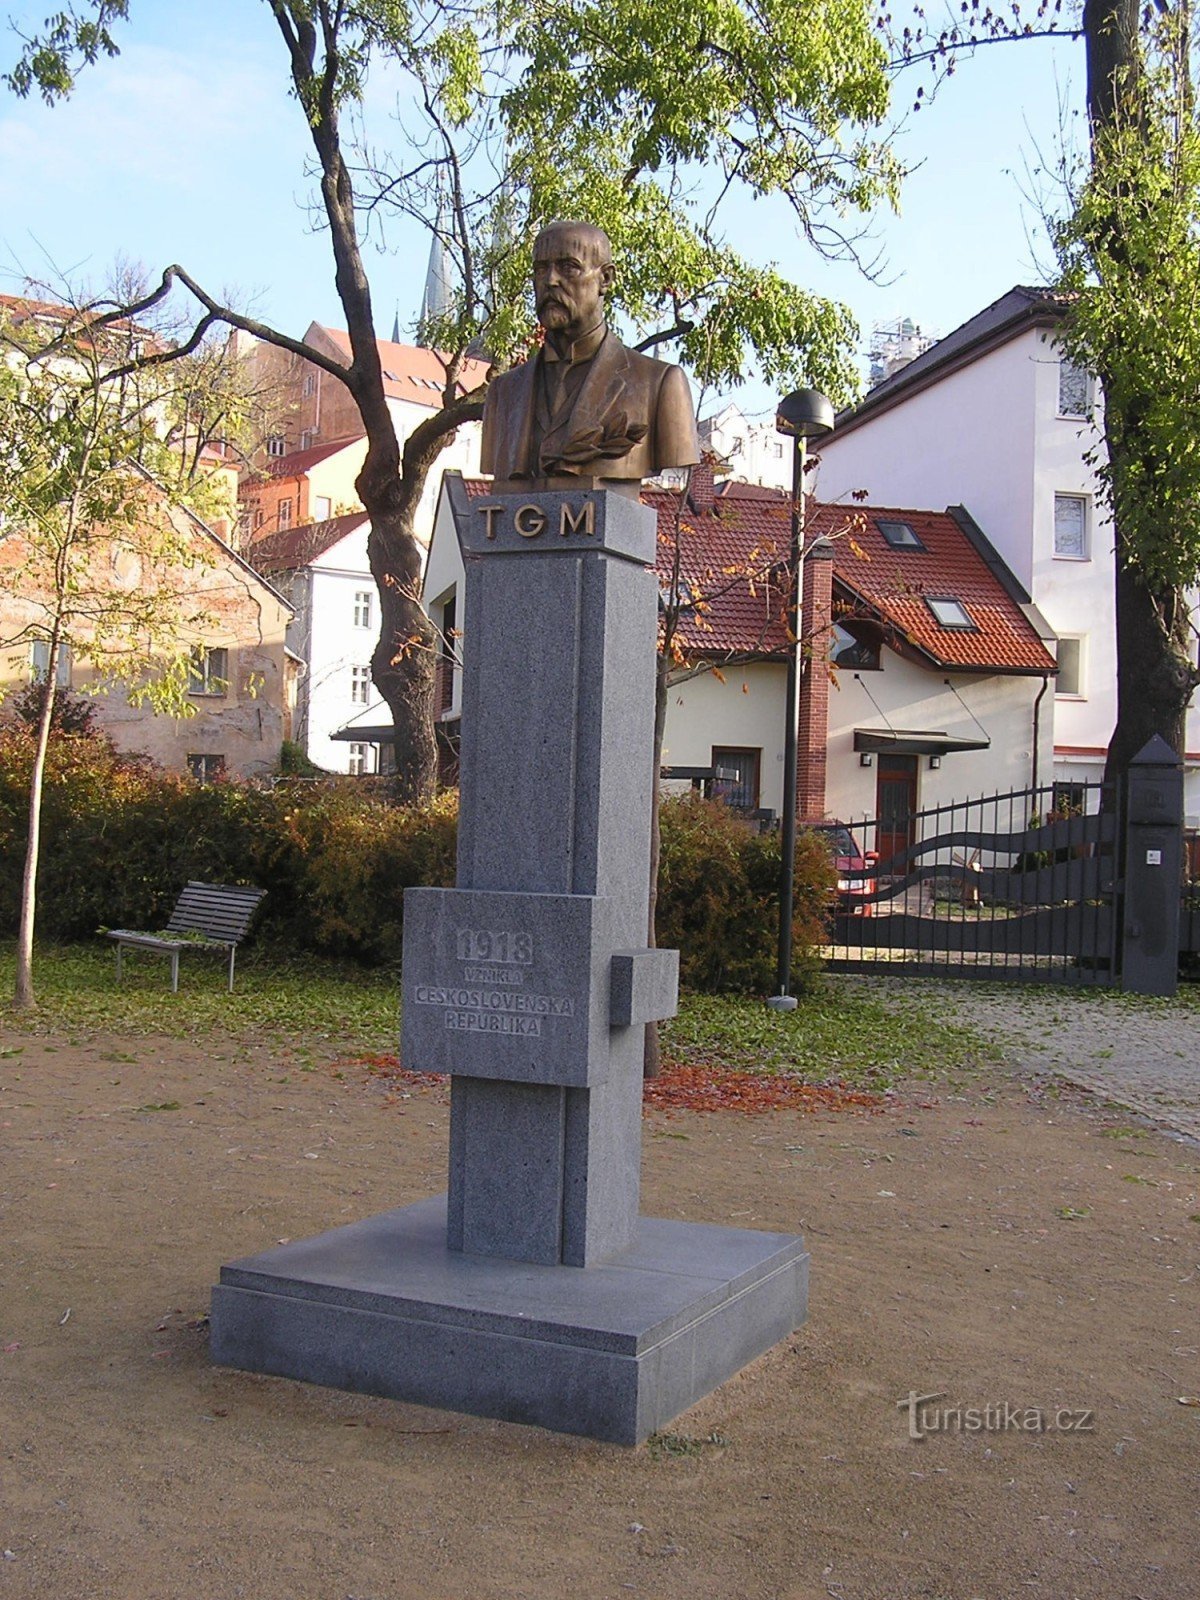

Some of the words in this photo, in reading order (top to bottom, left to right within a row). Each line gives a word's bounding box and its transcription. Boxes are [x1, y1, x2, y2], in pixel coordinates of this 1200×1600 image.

[478, 501, 596, 538] TGM
[459, 930, 532, 963] 1918
[445, 1012, 540, 1036] REPUBLIKA
